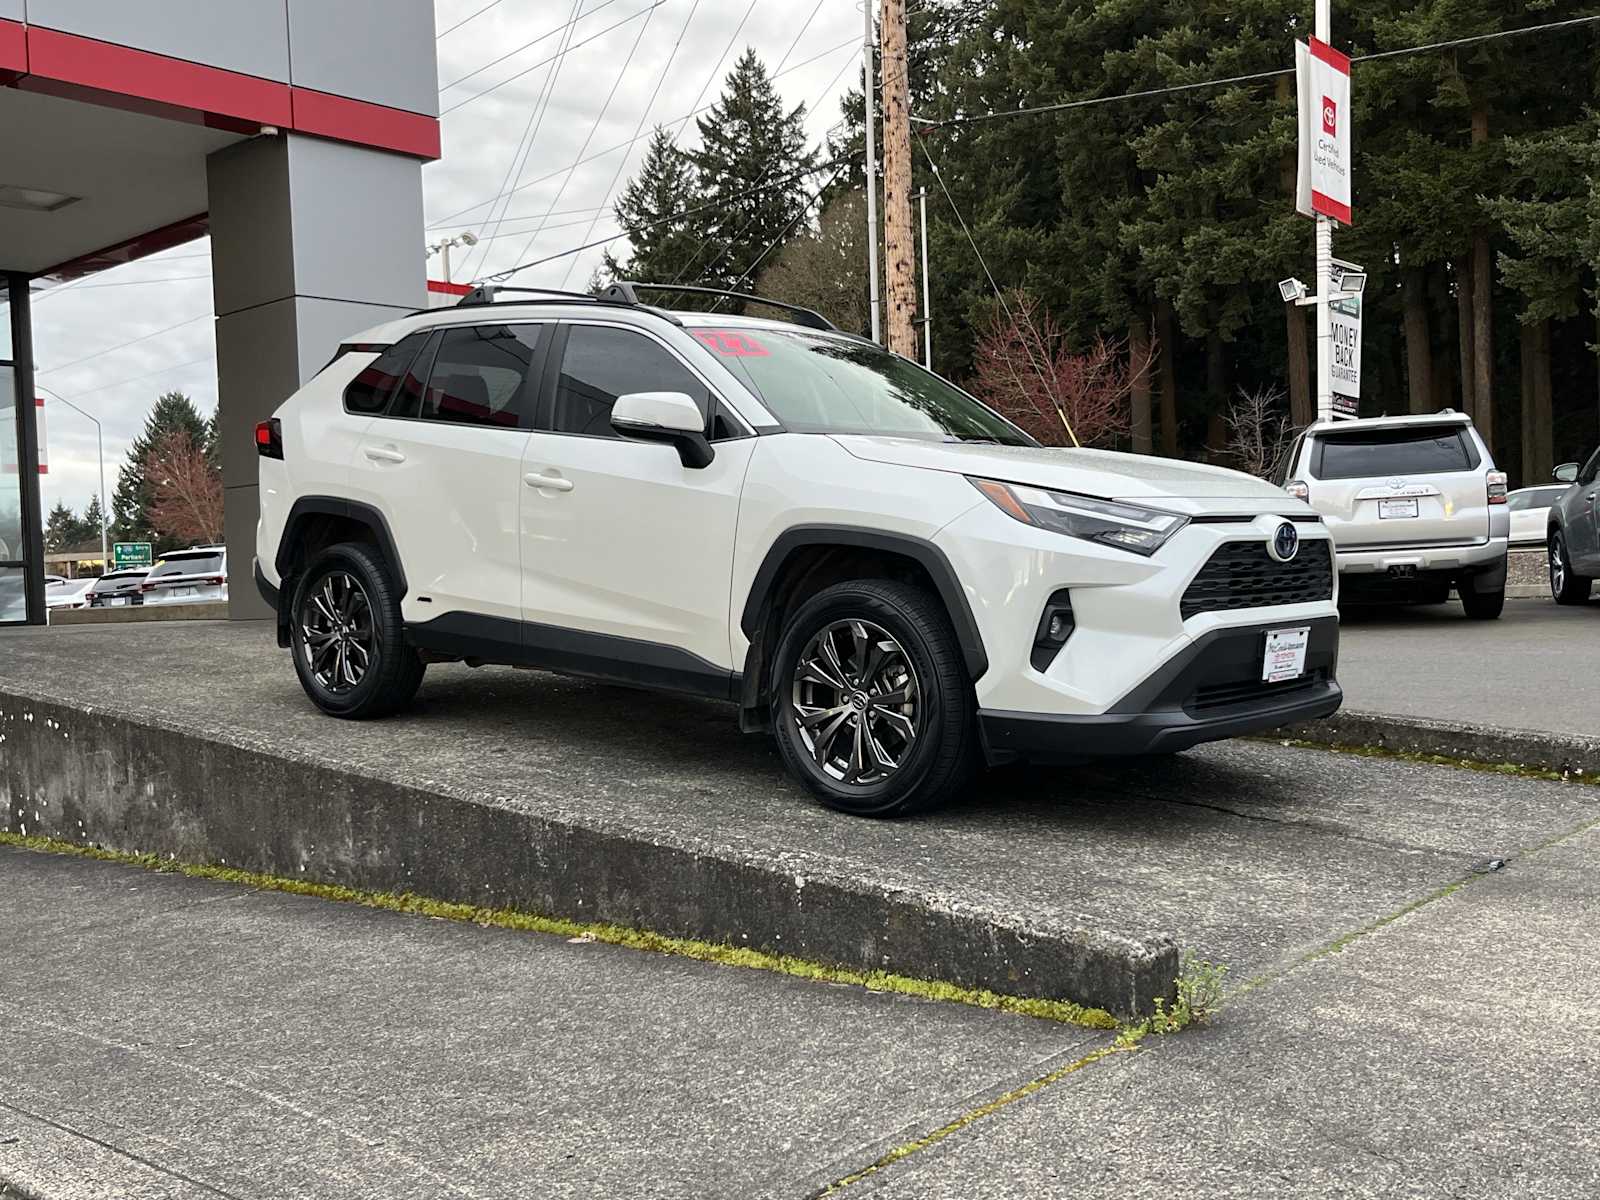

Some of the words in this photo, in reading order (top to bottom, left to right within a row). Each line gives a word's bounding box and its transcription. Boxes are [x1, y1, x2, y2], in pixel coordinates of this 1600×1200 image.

[1330, 322, 1358, 348] MONEY
[1335, 345, 1354, 369] BACK
[1331, 365, 1358, 384] GUARANTEE
